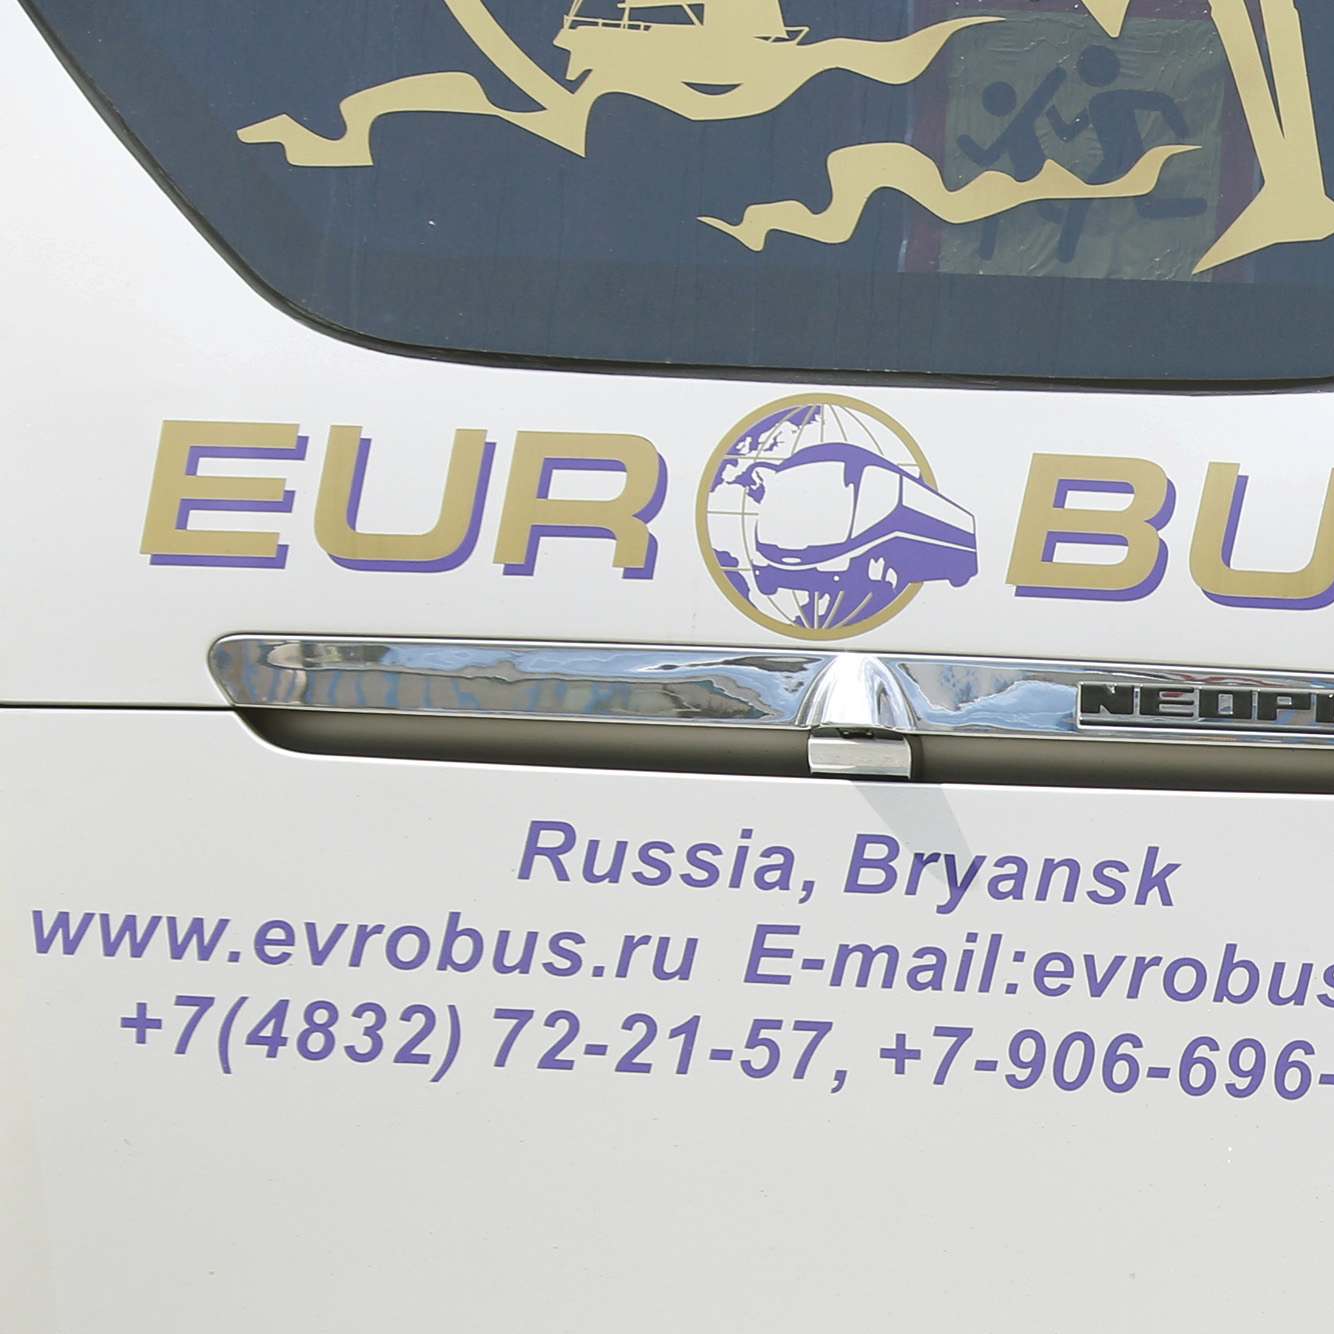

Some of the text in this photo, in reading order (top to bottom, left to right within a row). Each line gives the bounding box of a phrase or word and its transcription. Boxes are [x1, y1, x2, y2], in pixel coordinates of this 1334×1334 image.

[517, 819, 1182, 914] Russia, Bryansk
[30, 909, 699, 982] www.evrobus.ru
[119, 994, 462, 1083] +7(4832)
[491, 1007, 851, 1094] 72-21-57,
